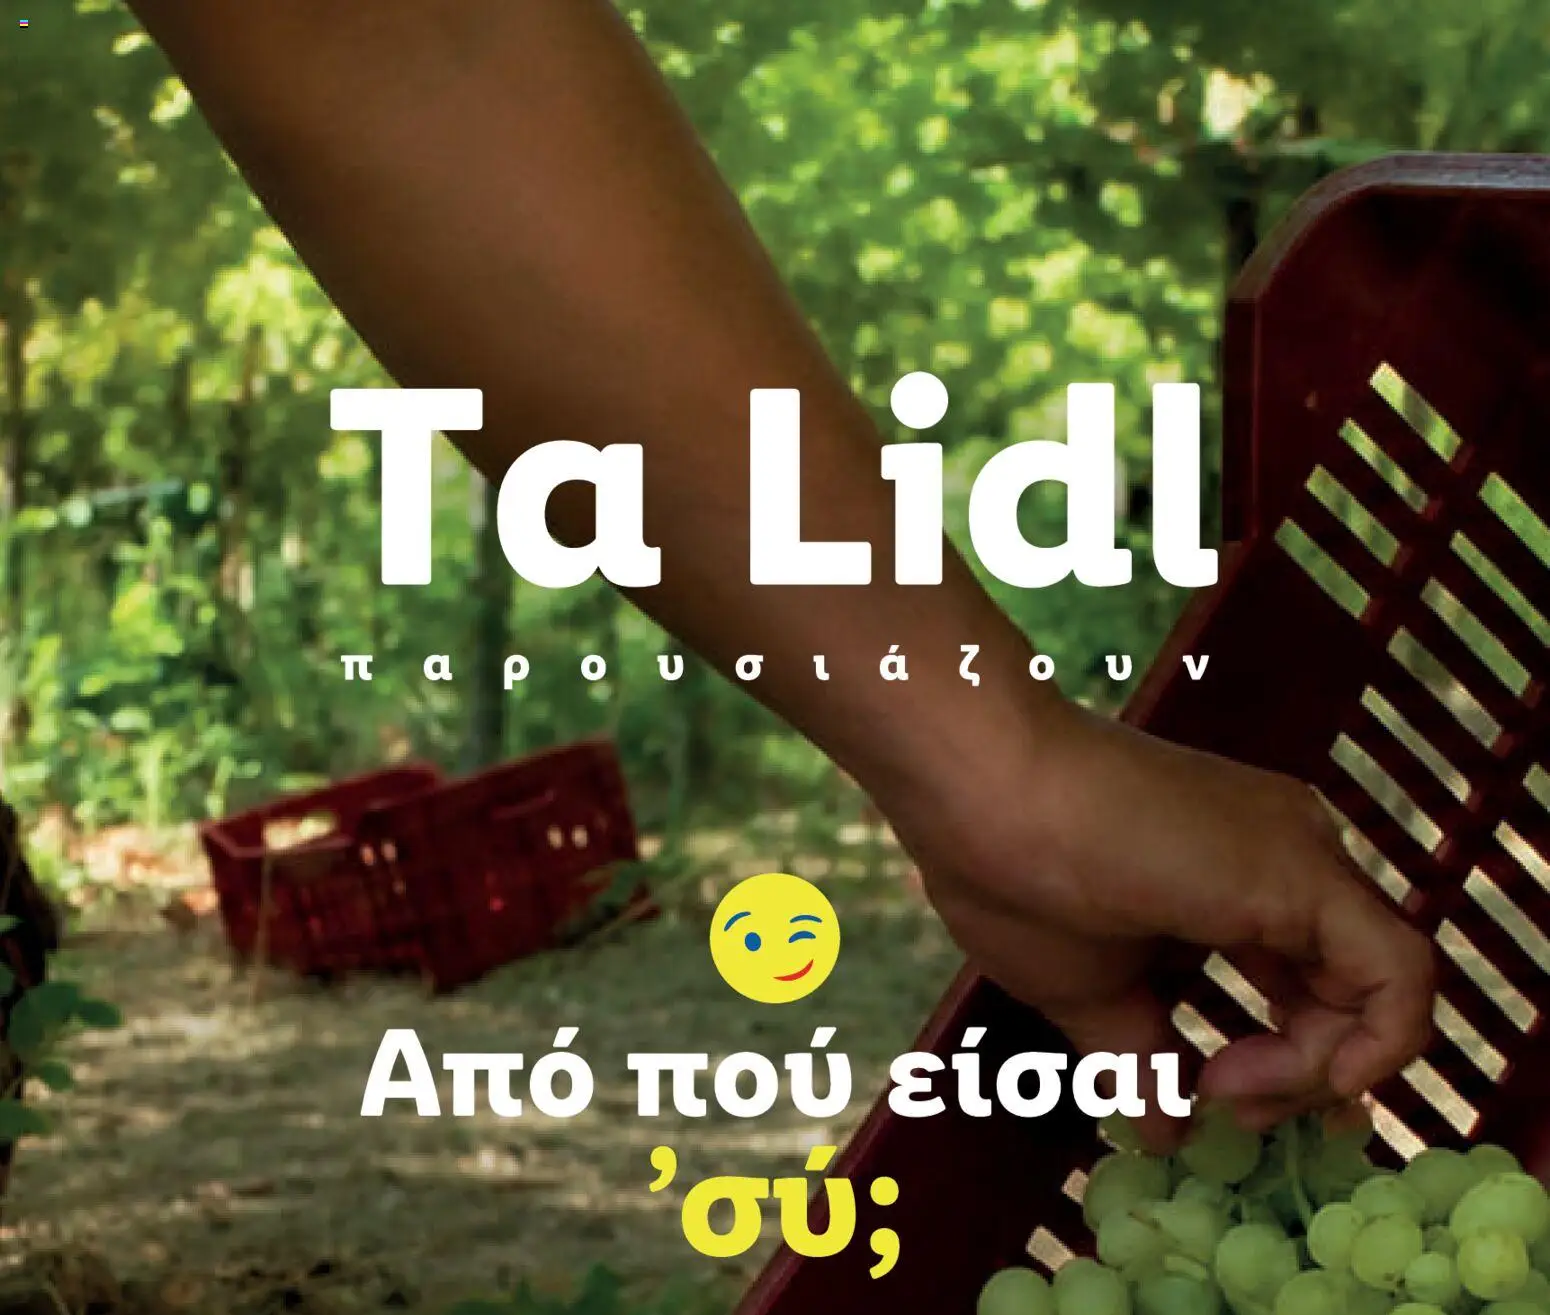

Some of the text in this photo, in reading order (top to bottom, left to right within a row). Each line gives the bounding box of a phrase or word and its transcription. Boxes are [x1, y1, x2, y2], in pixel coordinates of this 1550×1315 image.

[331, 372, 1217, 588] Τα Lidl
[341, 645, 1209, 689] παρουσιάζουν
[361, 1027, 1190, 1117] Από πού είσαι
